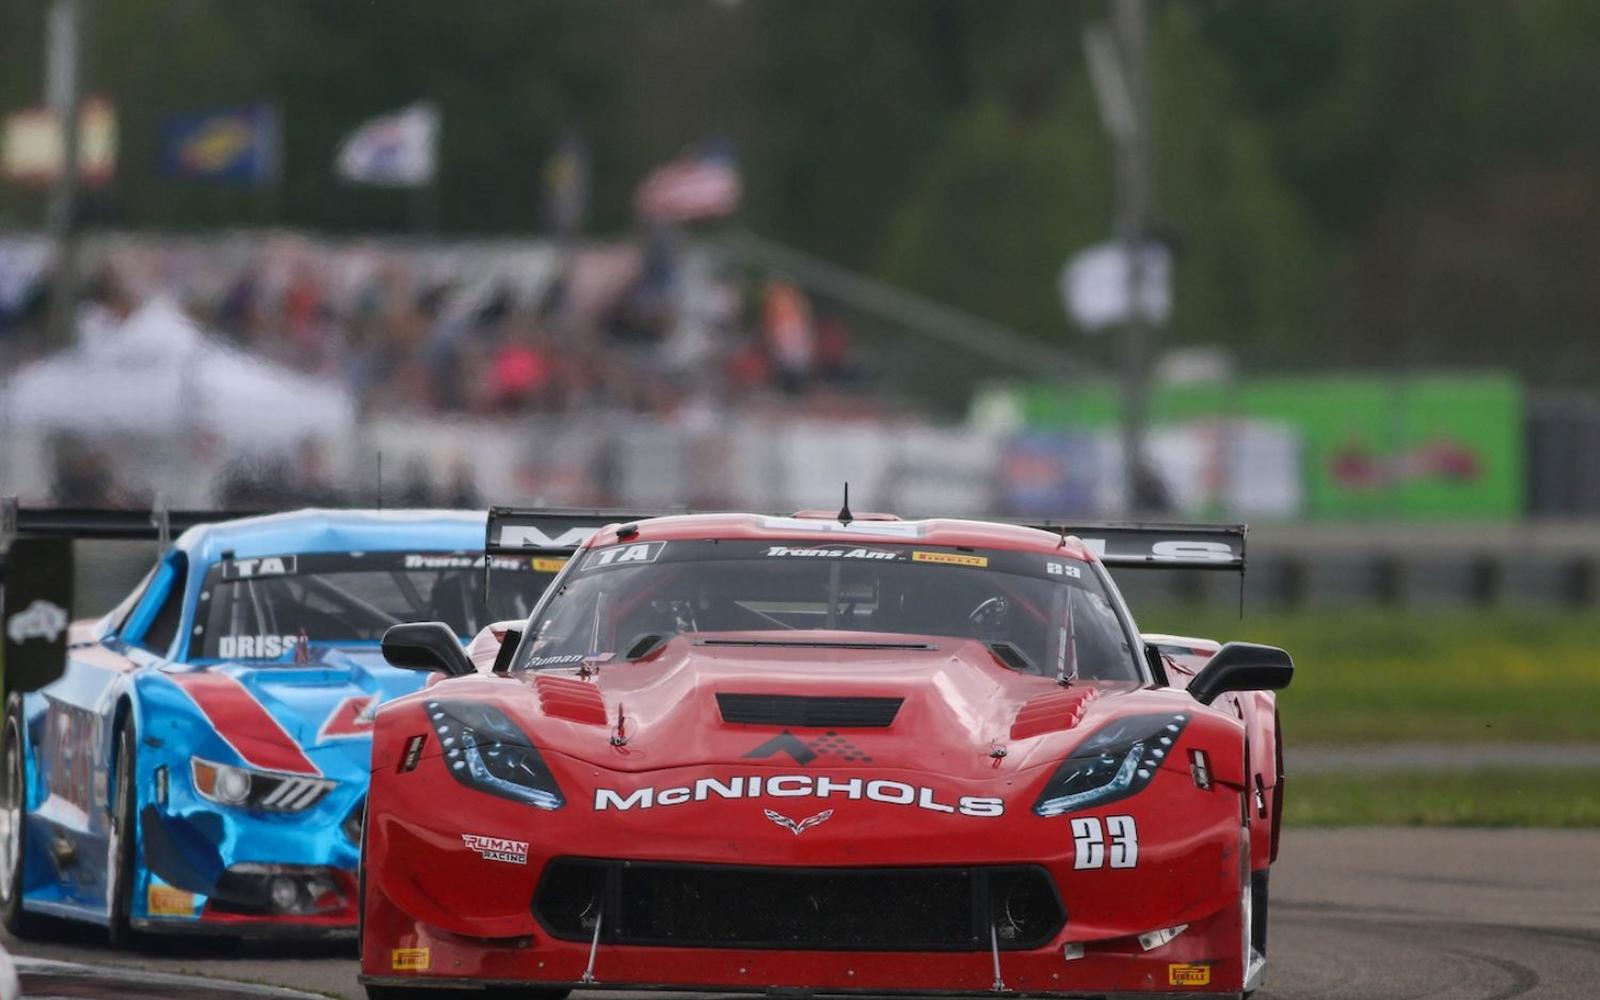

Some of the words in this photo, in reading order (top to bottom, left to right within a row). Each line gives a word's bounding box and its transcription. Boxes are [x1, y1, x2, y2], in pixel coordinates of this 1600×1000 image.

[599, 544, 649, 564] TA
[767, 546, 839, 557] Trans
[843, 549, 896, 560] Am
[233, 558, 286, 577] TA
[524, 655, 583, 669] Ruman
[594, 775, 1005, 817] McNICHOLS
[464, 836, 527, 853] RUMAN
[1070, 815, 1138, 870] 23
[484, 850, 526, 863] RACING
